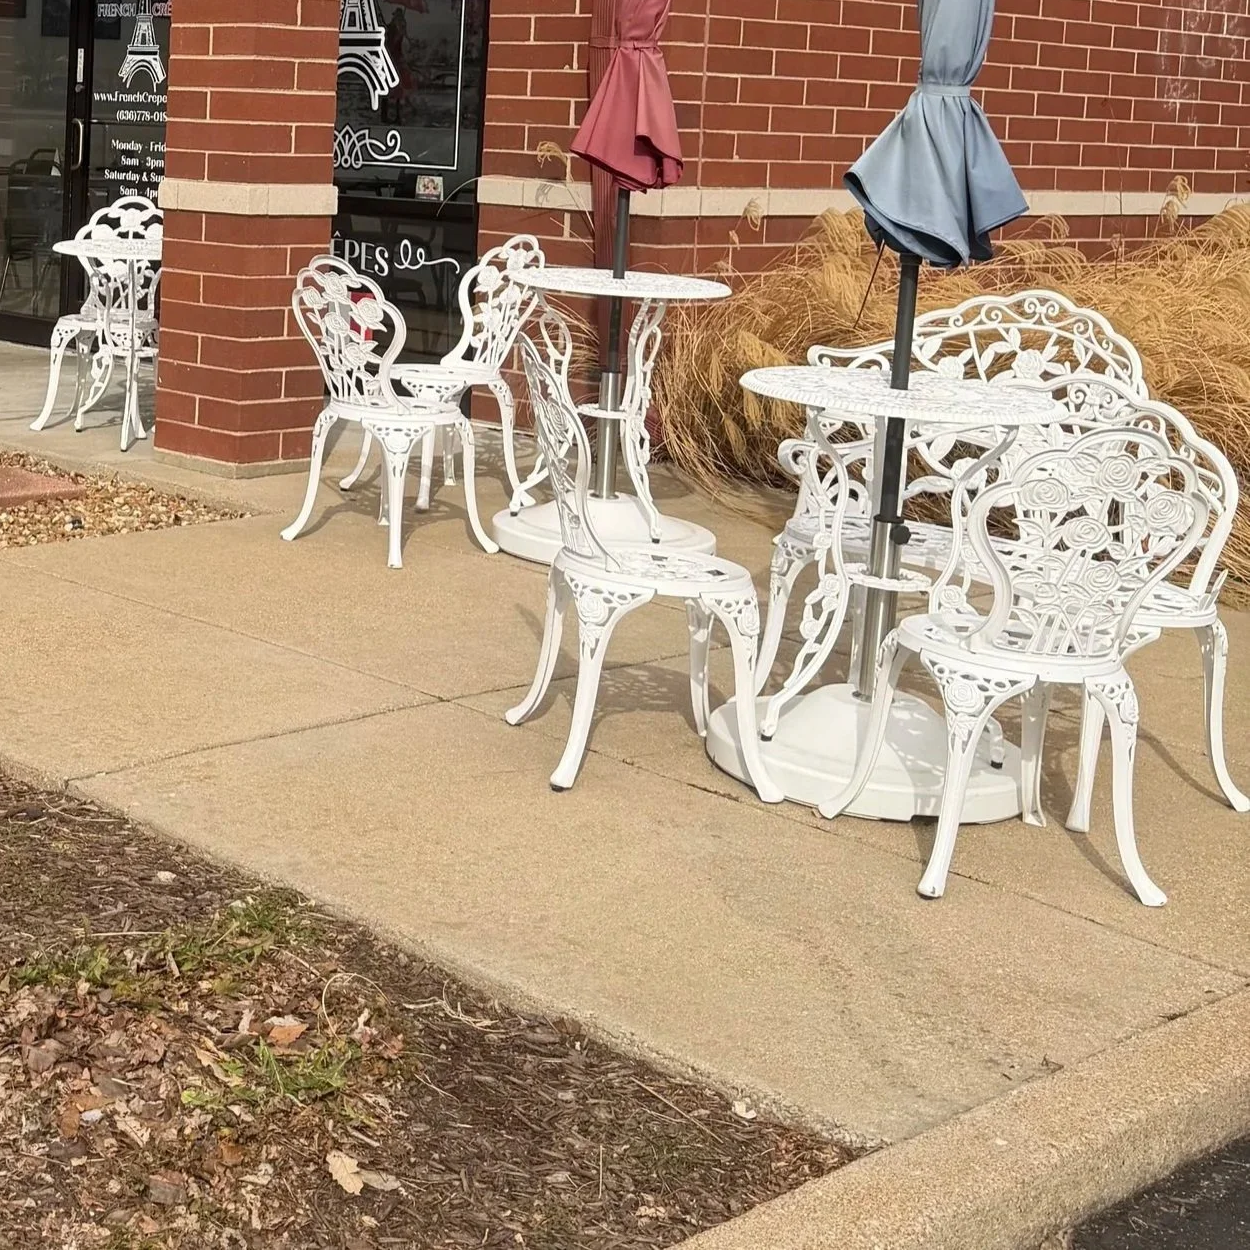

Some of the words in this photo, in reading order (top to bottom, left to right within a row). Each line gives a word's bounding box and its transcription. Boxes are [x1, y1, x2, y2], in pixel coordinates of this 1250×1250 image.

[97, 3, 136, 17] FRENCH
[111, 139, 143, 154] Monday
[121, 155, 139, 166] 8am
[146, 157, 164, 169] 3pm
[104, 169, 140, 183] Saturday
[142, 172, 148, 182] &
[120, 185, 138, 197] 8am
